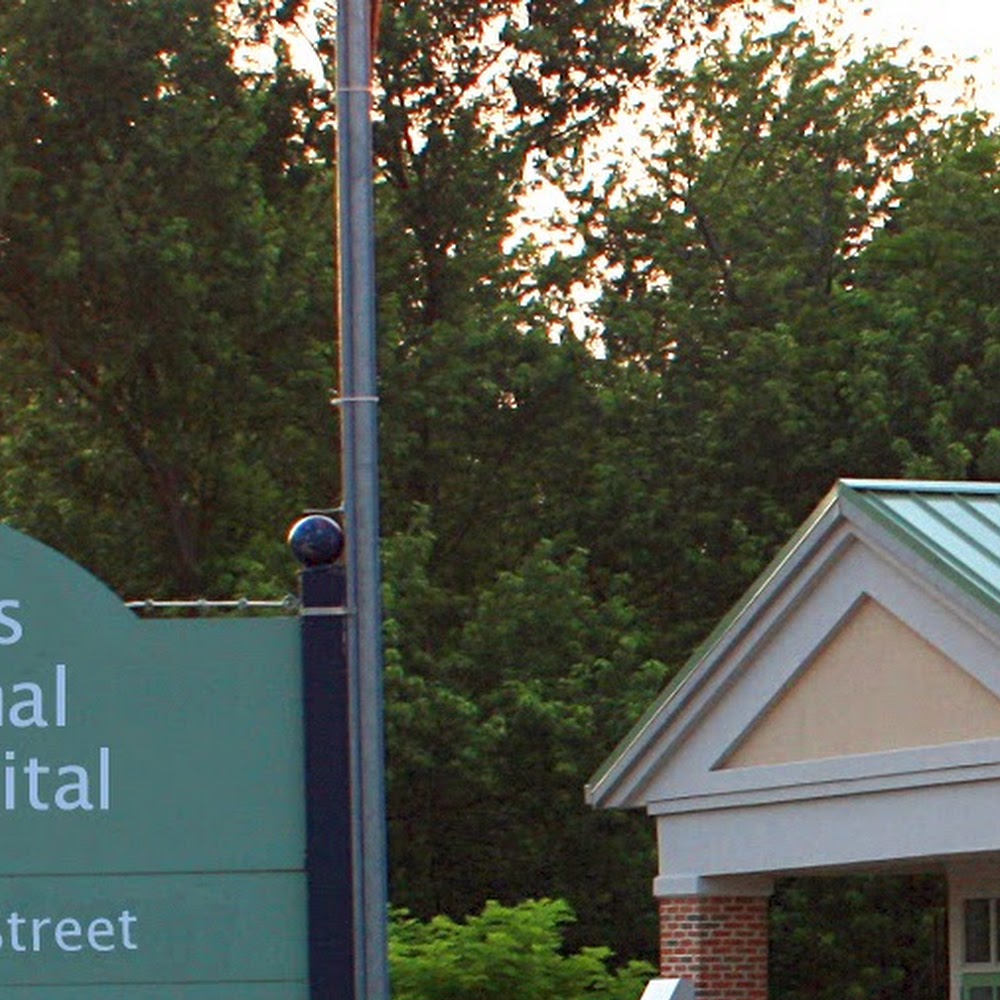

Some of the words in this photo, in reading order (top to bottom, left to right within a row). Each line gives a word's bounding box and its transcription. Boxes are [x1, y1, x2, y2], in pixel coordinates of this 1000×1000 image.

[0, 664, 66, 727] al
[5, 747, 110, 811] ital
[0, 910, 138, 951] treet
